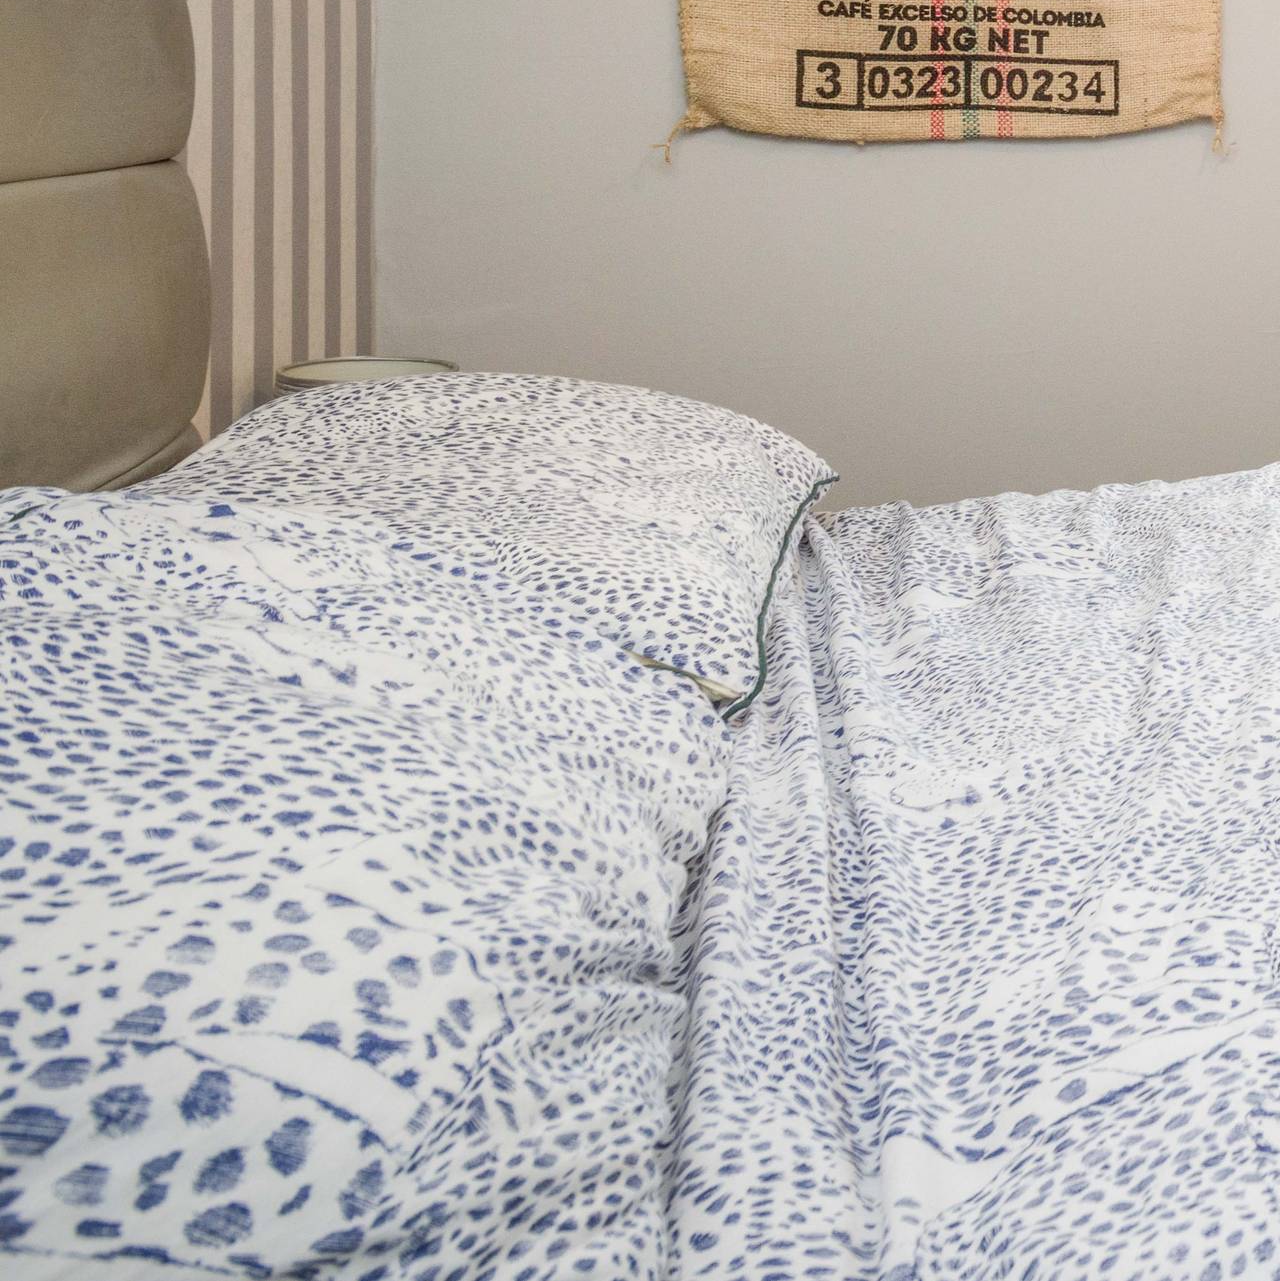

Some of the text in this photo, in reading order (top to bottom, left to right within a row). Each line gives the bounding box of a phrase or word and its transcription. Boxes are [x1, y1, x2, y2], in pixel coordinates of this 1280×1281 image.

[817, 0, 1106, 28] CAFÉ EXCELSO DE COLOMBIA
[877, 24, 1049, 54] 70 KG NET
[815, 61, 1106, 103] 3 0323 00234
